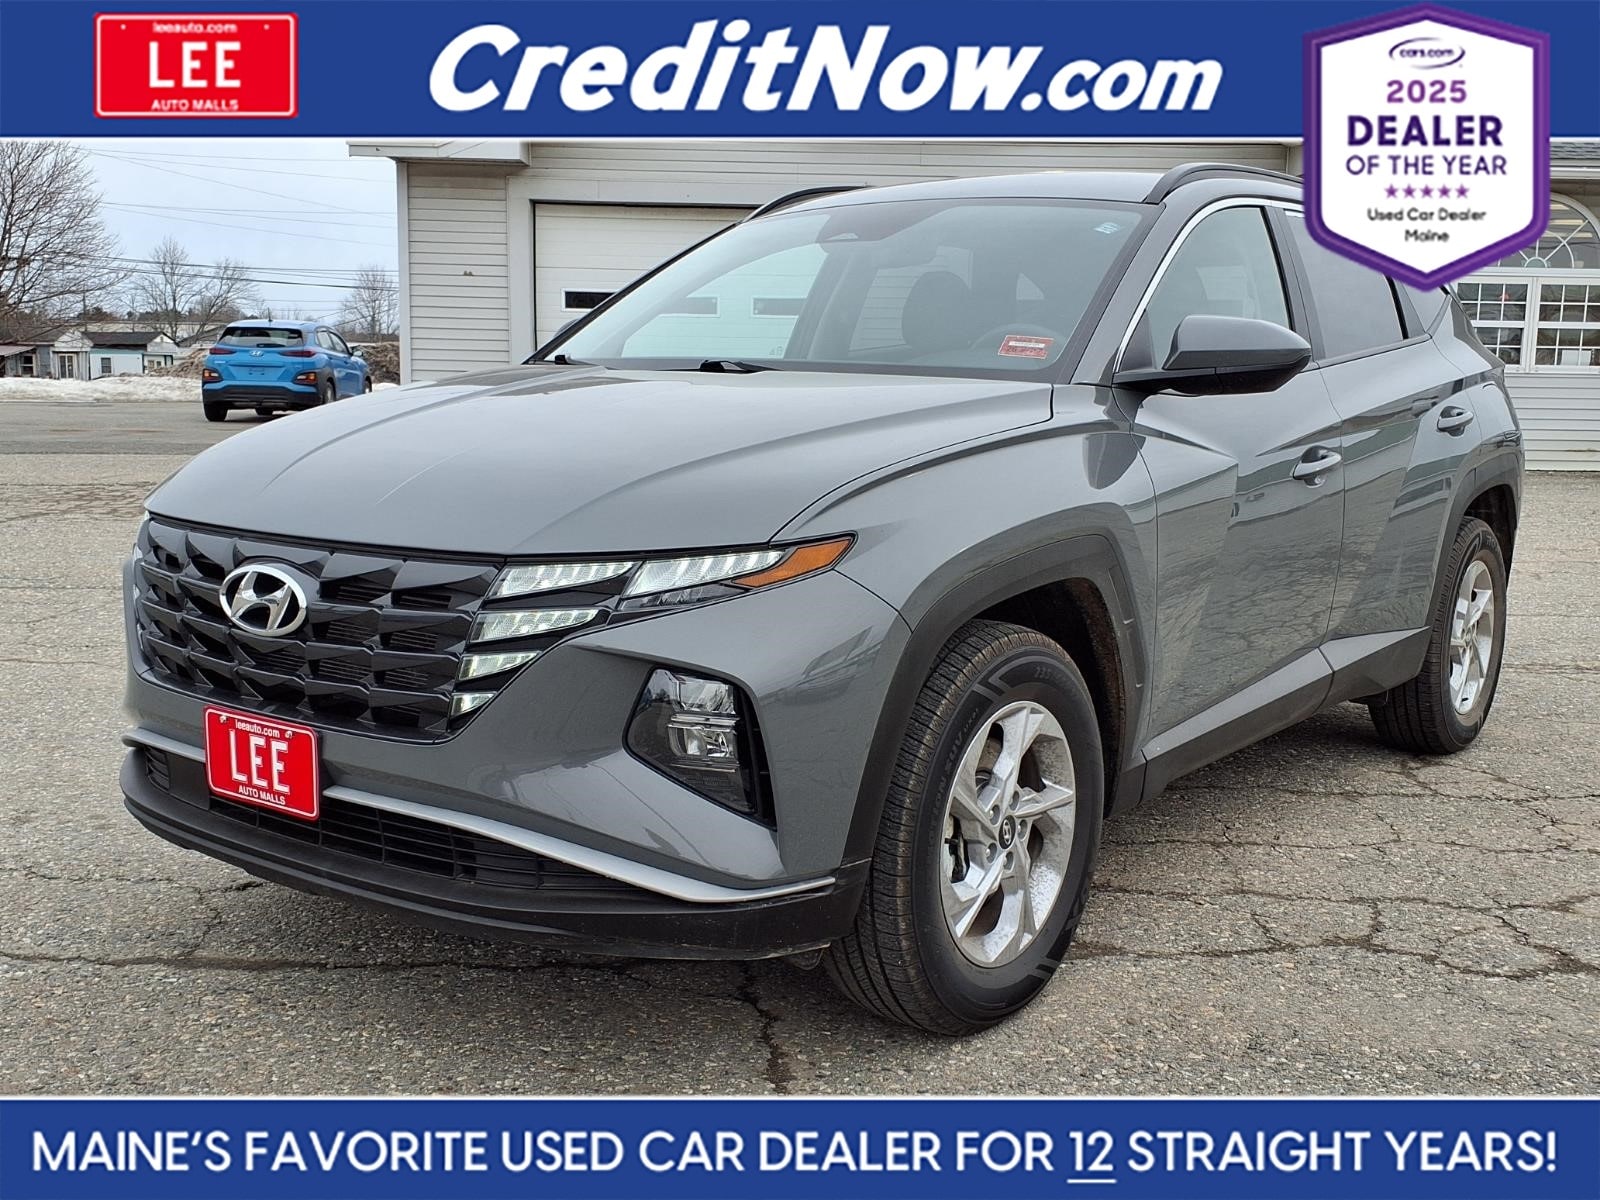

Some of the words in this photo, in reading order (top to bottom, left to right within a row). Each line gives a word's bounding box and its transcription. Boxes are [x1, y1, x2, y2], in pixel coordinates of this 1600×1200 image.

[235, 719, 280, 738] leeauto.com
[229, 729, 290, 795] LEE
[238, 785, 259, 798] AUTO
[260, 790, 286, 806] MALLS
